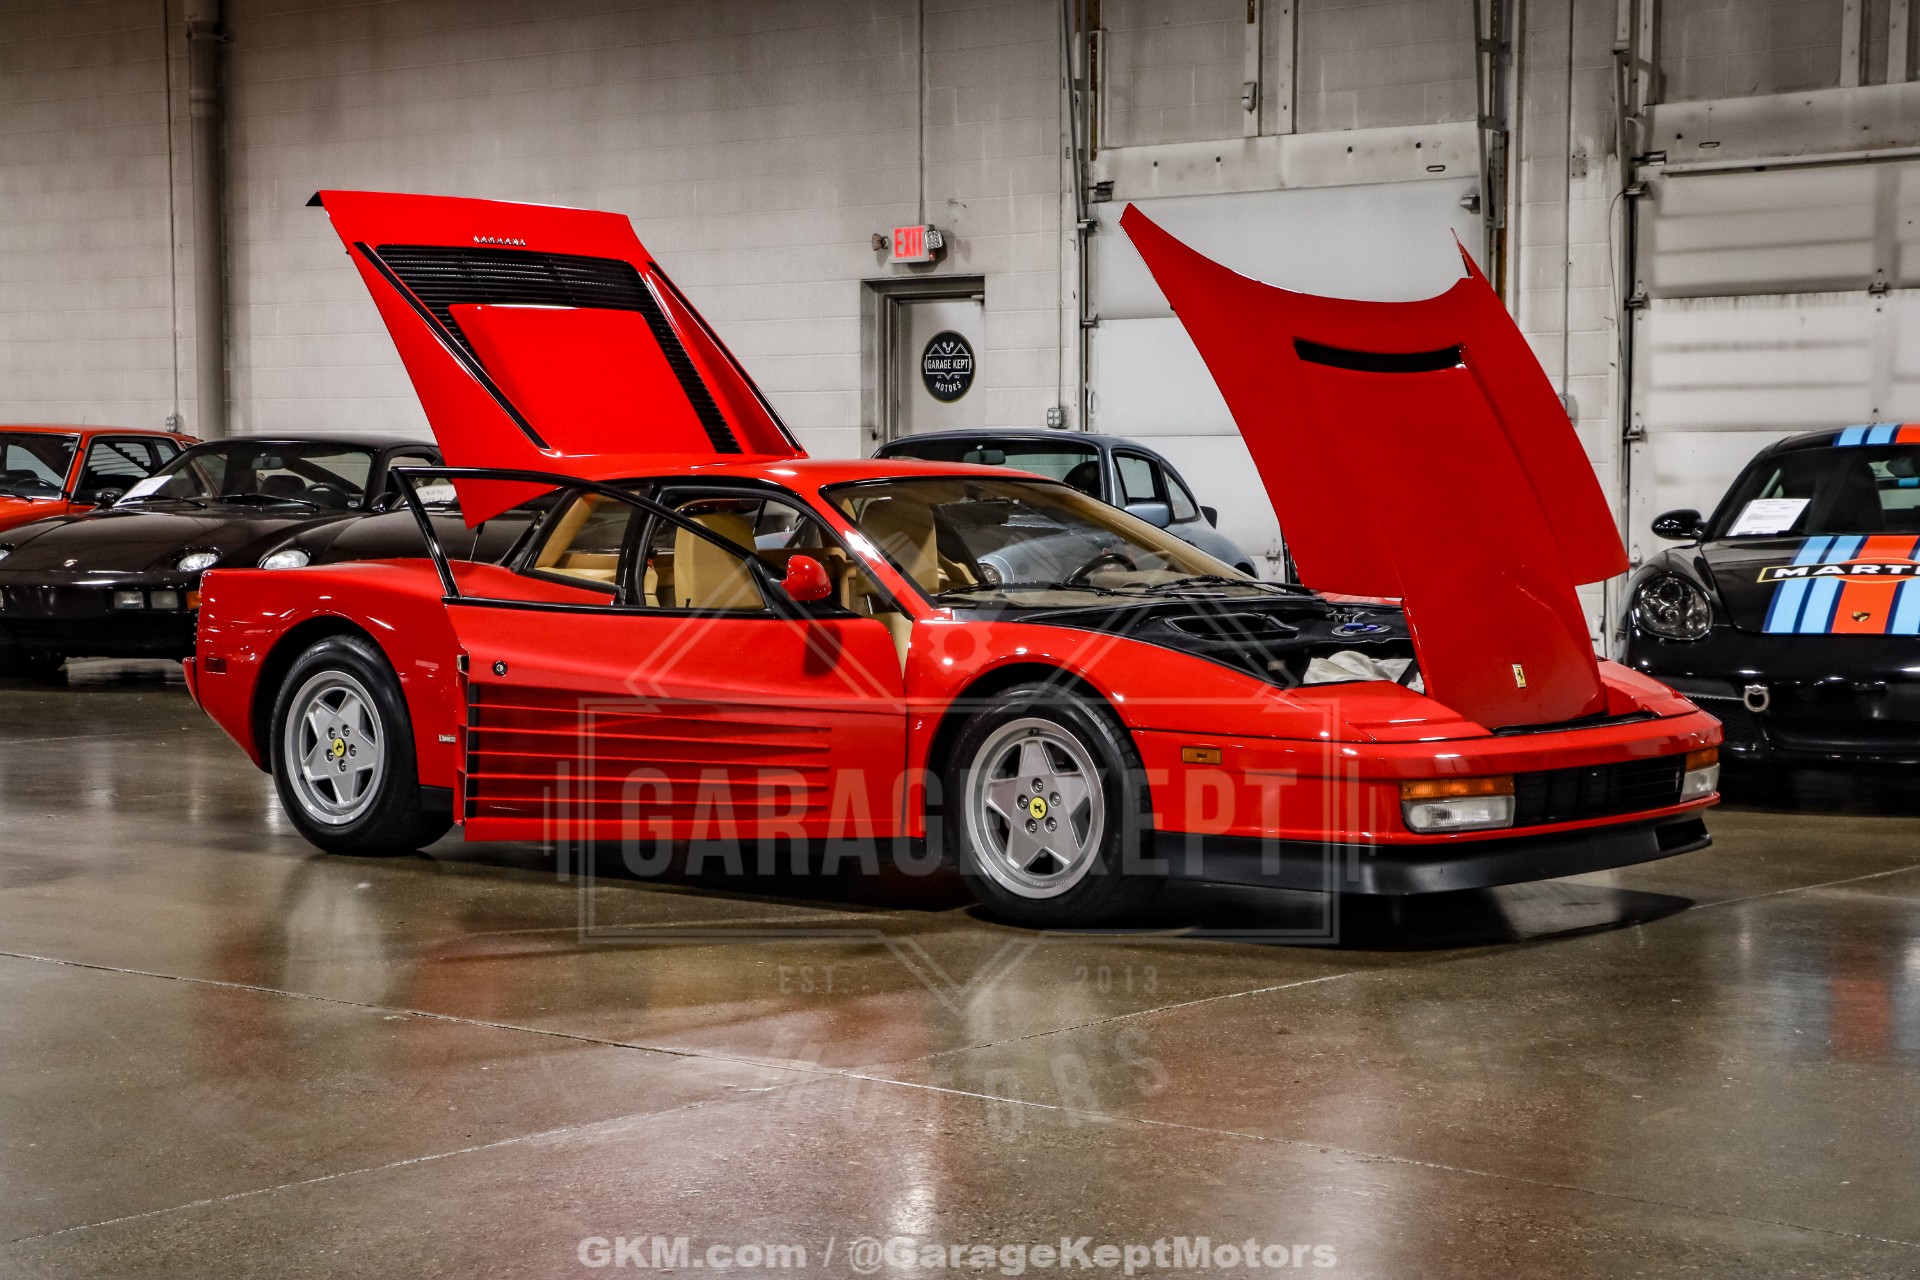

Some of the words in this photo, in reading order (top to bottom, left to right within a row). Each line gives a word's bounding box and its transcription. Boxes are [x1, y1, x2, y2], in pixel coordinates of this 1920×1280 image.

[894, 226, 924, 258] EXIT
[927, 359, 951, 369] GARAGE
[953, 359, 968, 369] KEPT
[935, 381, 961, 393] MOTORS
